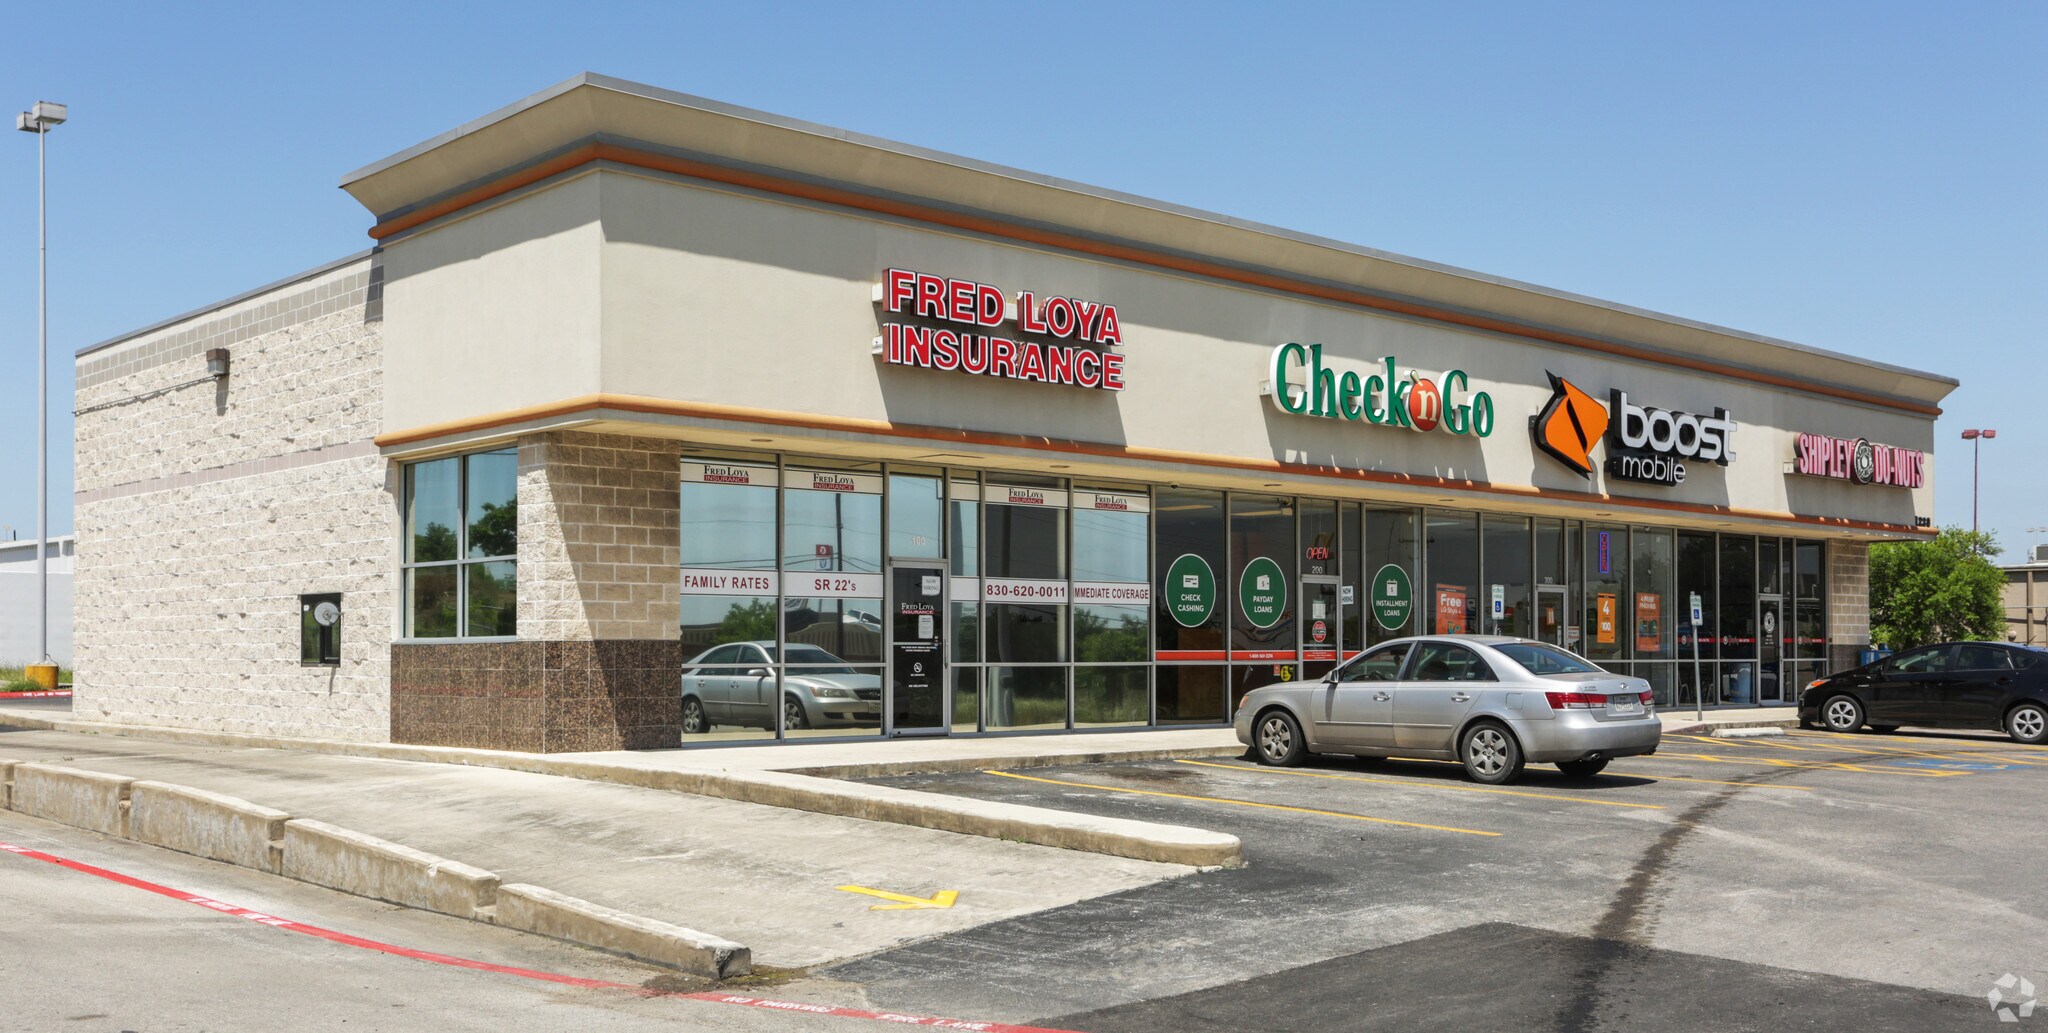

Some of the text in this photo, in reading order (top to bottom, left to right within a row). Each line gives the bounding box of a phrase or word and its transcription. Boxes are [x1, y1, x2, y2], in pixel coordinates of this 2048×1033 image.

[886, 268, 1124, 346] FRED LOYA
[888, 323, 1126, 391] INSURANCE
[1272, 342, 1411, 428] Check
[1441, 369, 1494, 438] Go
[1620, 391, 1738, 463] boost
[1800, 433, 1853, 479] SHIPLEY
[1874, 445, 1924, 489] DO-NUTS
[1622, 456, 1686, 483] mobile
[704, 475, 749, 484] INSURANCE
[813, 483, 854, 491] INSURANCE
[912, 536, 926, 546] 100
[1306, 547, 1329, 560] OPEN
[1312, 566, 1323, 574] 200
[684, 575, 769, 590] FAMILY RATES
[814, 579, 856, 592] SR 22's
[986, 584, 1066, 597] 830-620-0011
[1111, 588, 1149, 600] COVERAGE
[1343, 589, 1351, 597] NOW
[1181, 593, 1201, 602] CHECK
[1253, 595, 1273, 603] PAYDAY
[1441, 593, 1462, 607] Free
[1178, 604, 1204, 612] CASHING
[1254, 605, 1272, 613] LOANS
[1384, 609, 1400, 617] LOANS
[1603, 600, 1610, 615] 4
[754, 1000, 835, 1013] PARKING
[876, 1013, 920, 1024] FIRE
[932, 1019, 992, 1031] LANE
